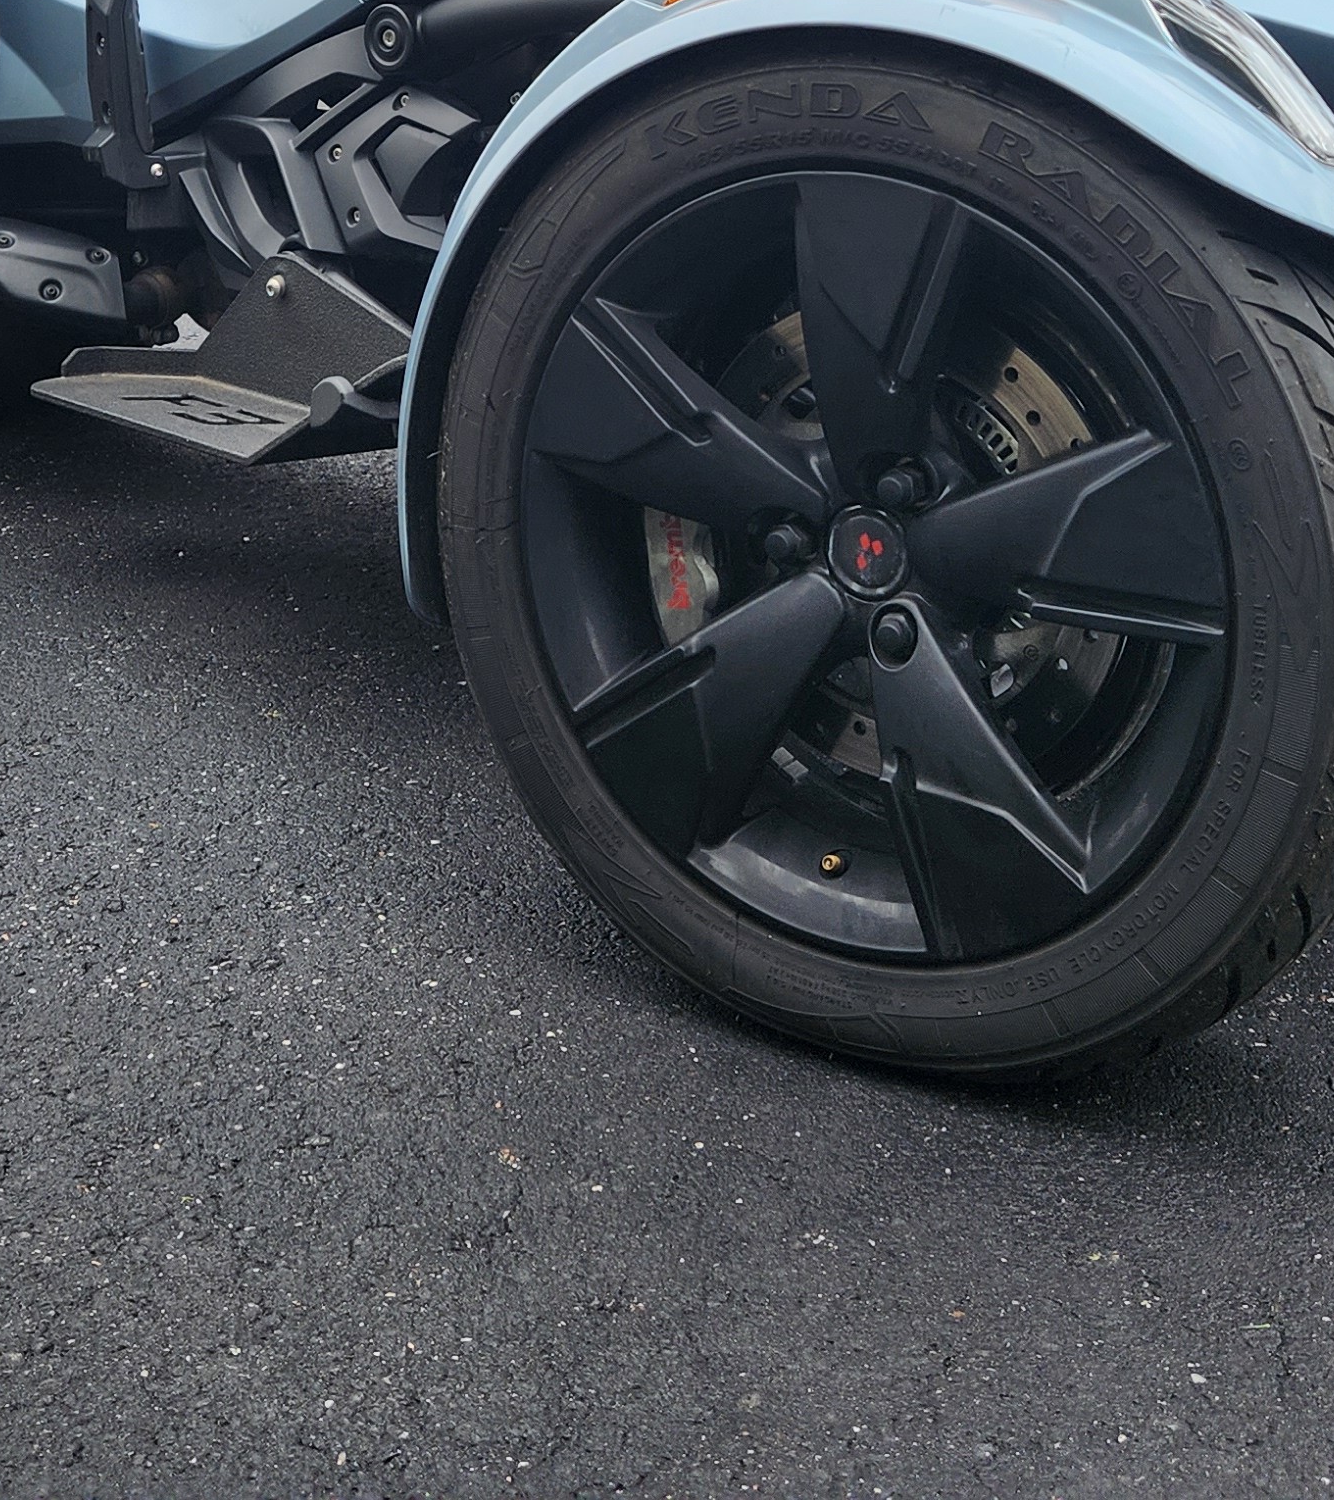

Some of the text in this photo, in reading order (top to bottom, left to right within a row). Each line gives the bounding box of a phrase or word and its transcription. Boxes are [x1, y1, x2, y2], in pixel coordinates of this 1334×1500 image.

[644, 82, 932, 161] KENDA
[979, 121, 1251, 410] RADIAL
[659, 513, 692, 609] bremb
[1223, 745, 1252, 793] FOR
[1178, 797, 1233, 875] SPECIAL
[1066, 878, 1181, 975] MOTORCYCLE
[1024, 965, 1062, 994] USE
